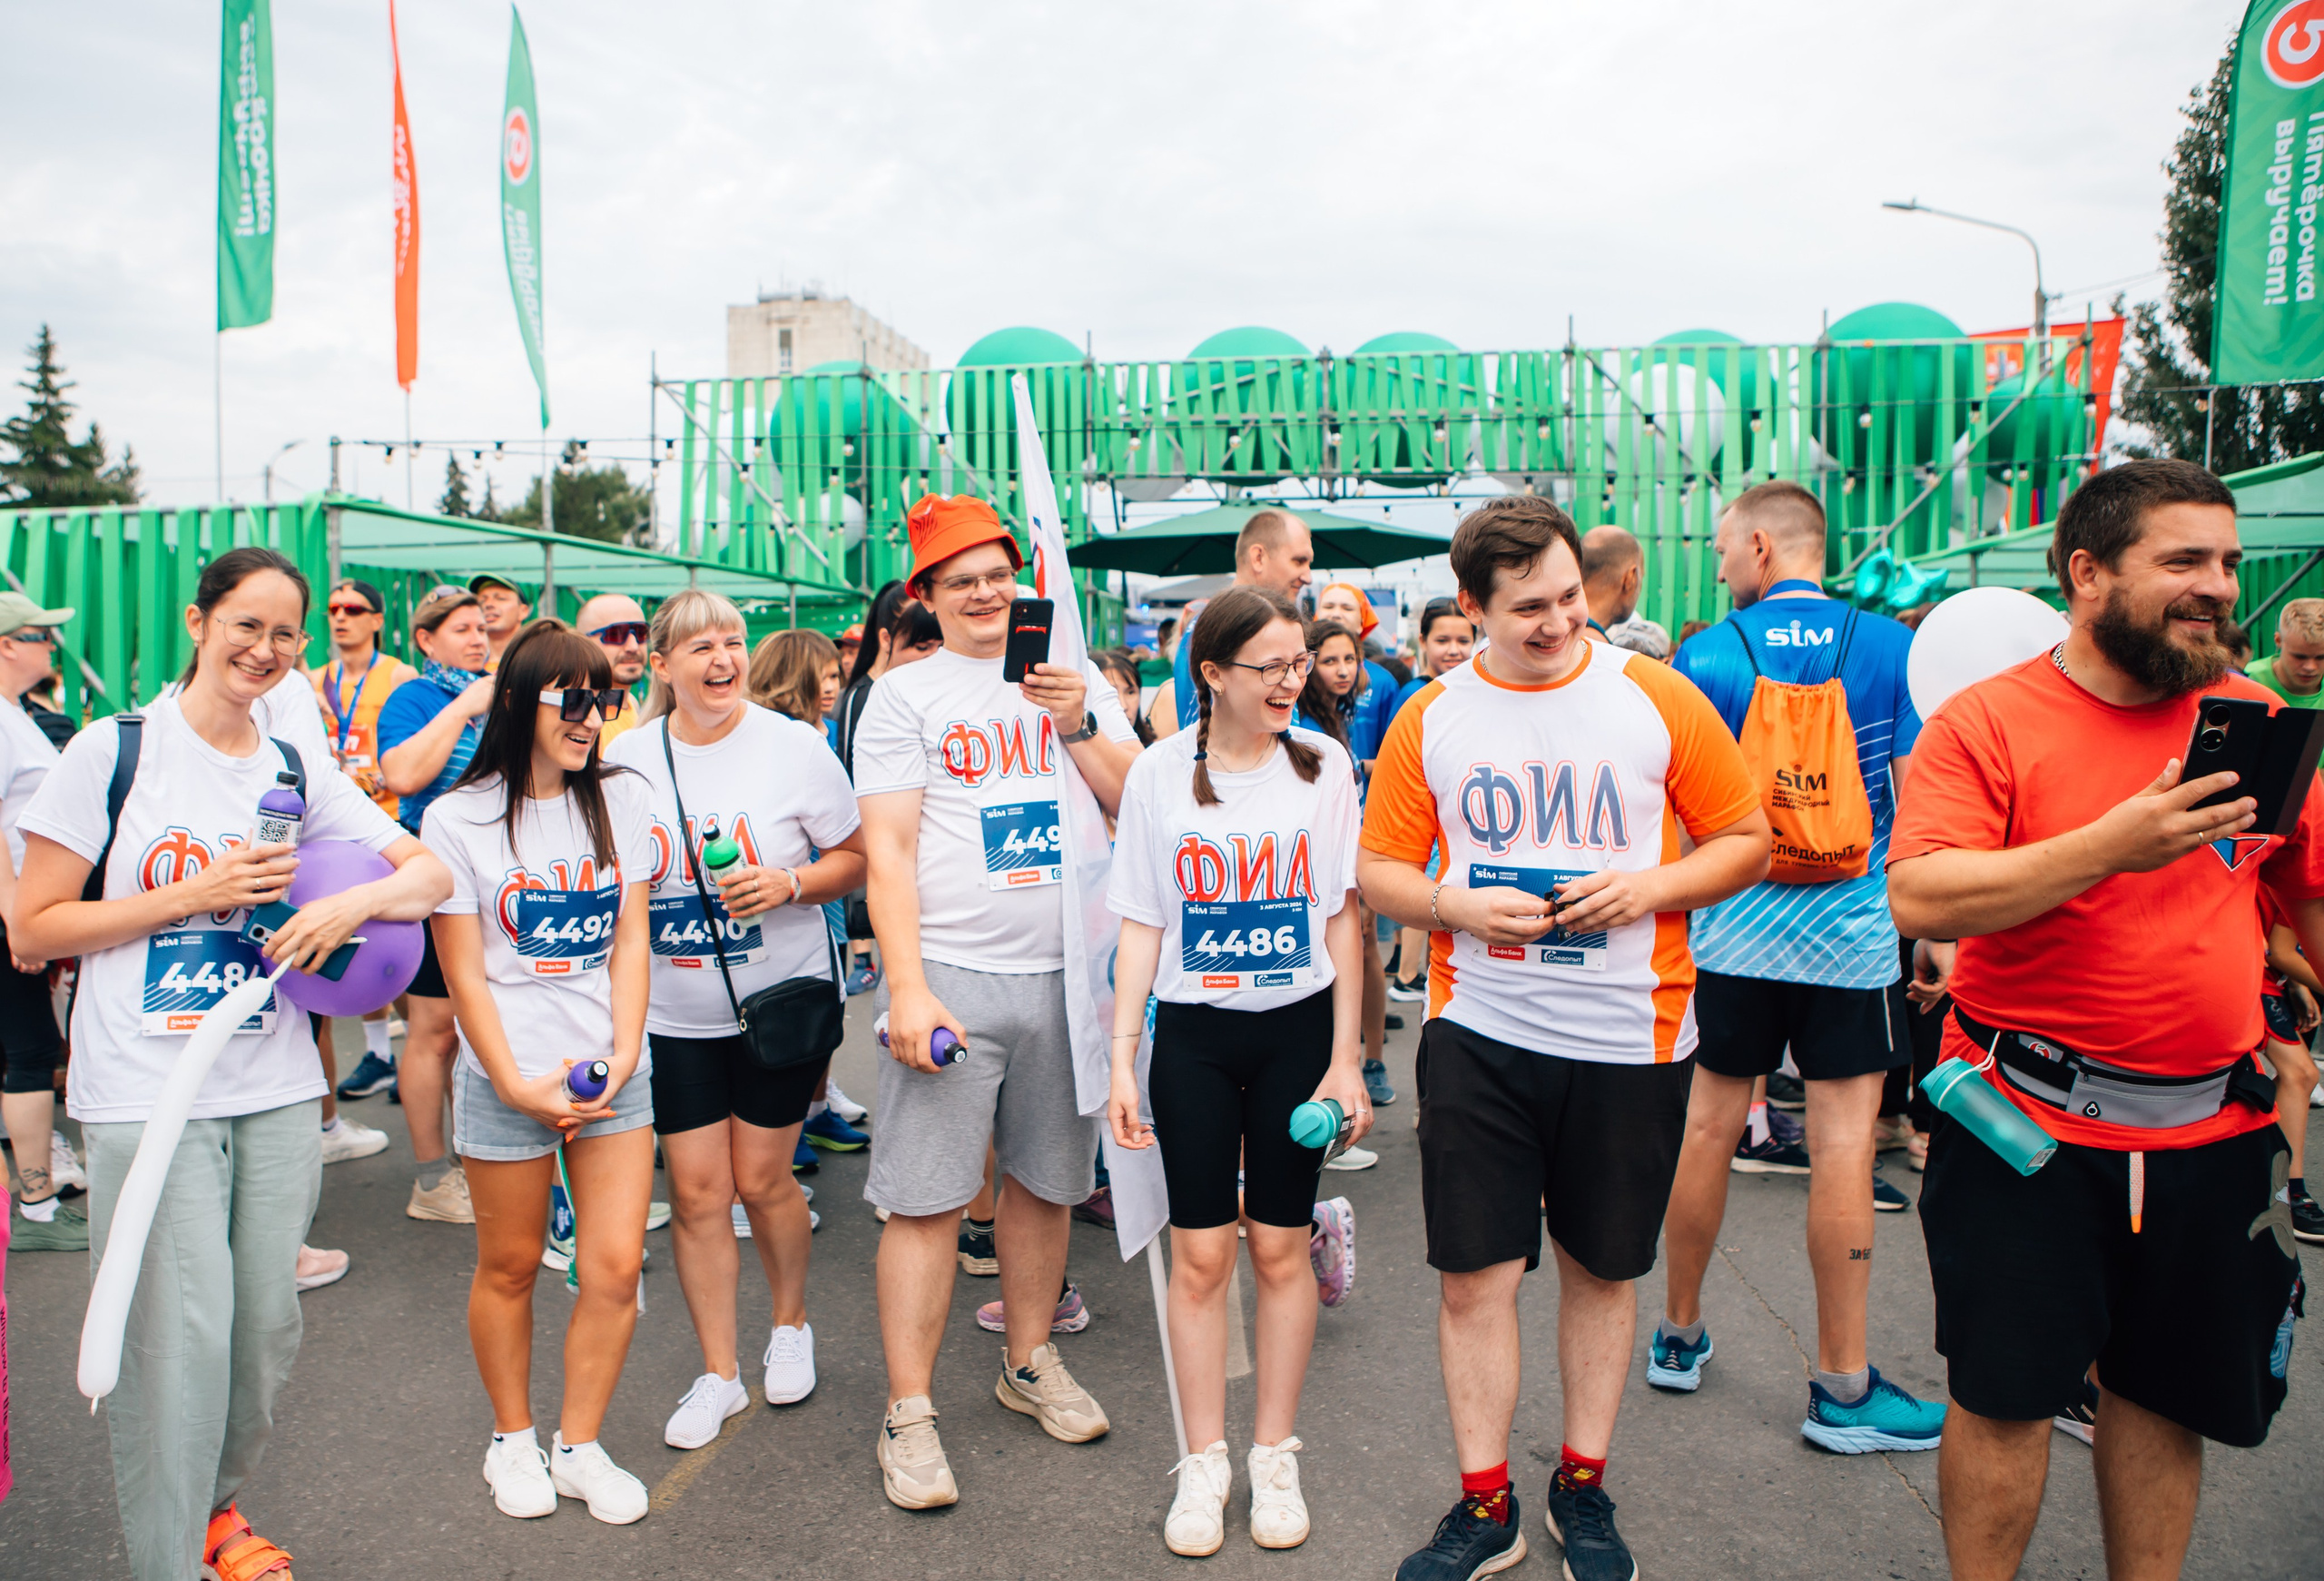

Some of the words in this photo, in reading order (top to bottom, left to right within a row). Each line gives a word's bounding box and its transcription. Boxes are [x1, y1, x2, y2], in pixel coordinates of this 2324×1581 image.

[2263, 118, 2296, 305] выручает!
[1458, 760, 1630, 857] ФИЛ
[1002, 825, 1060, 855] 449
[1173, 829, 1319, 907] ФИЛ
[532, 911, 613, 944] 4492
[659, 918, 747, 944] 4490
[1196, 925, 1296, 957] 4486
[1491, 947, 1507, 955] Альфа
[1548, 954, 1581, 962] Следопыт
[159, 962, 260, 994] 448
[1823, 1405, 1857, 1427] HOKA
